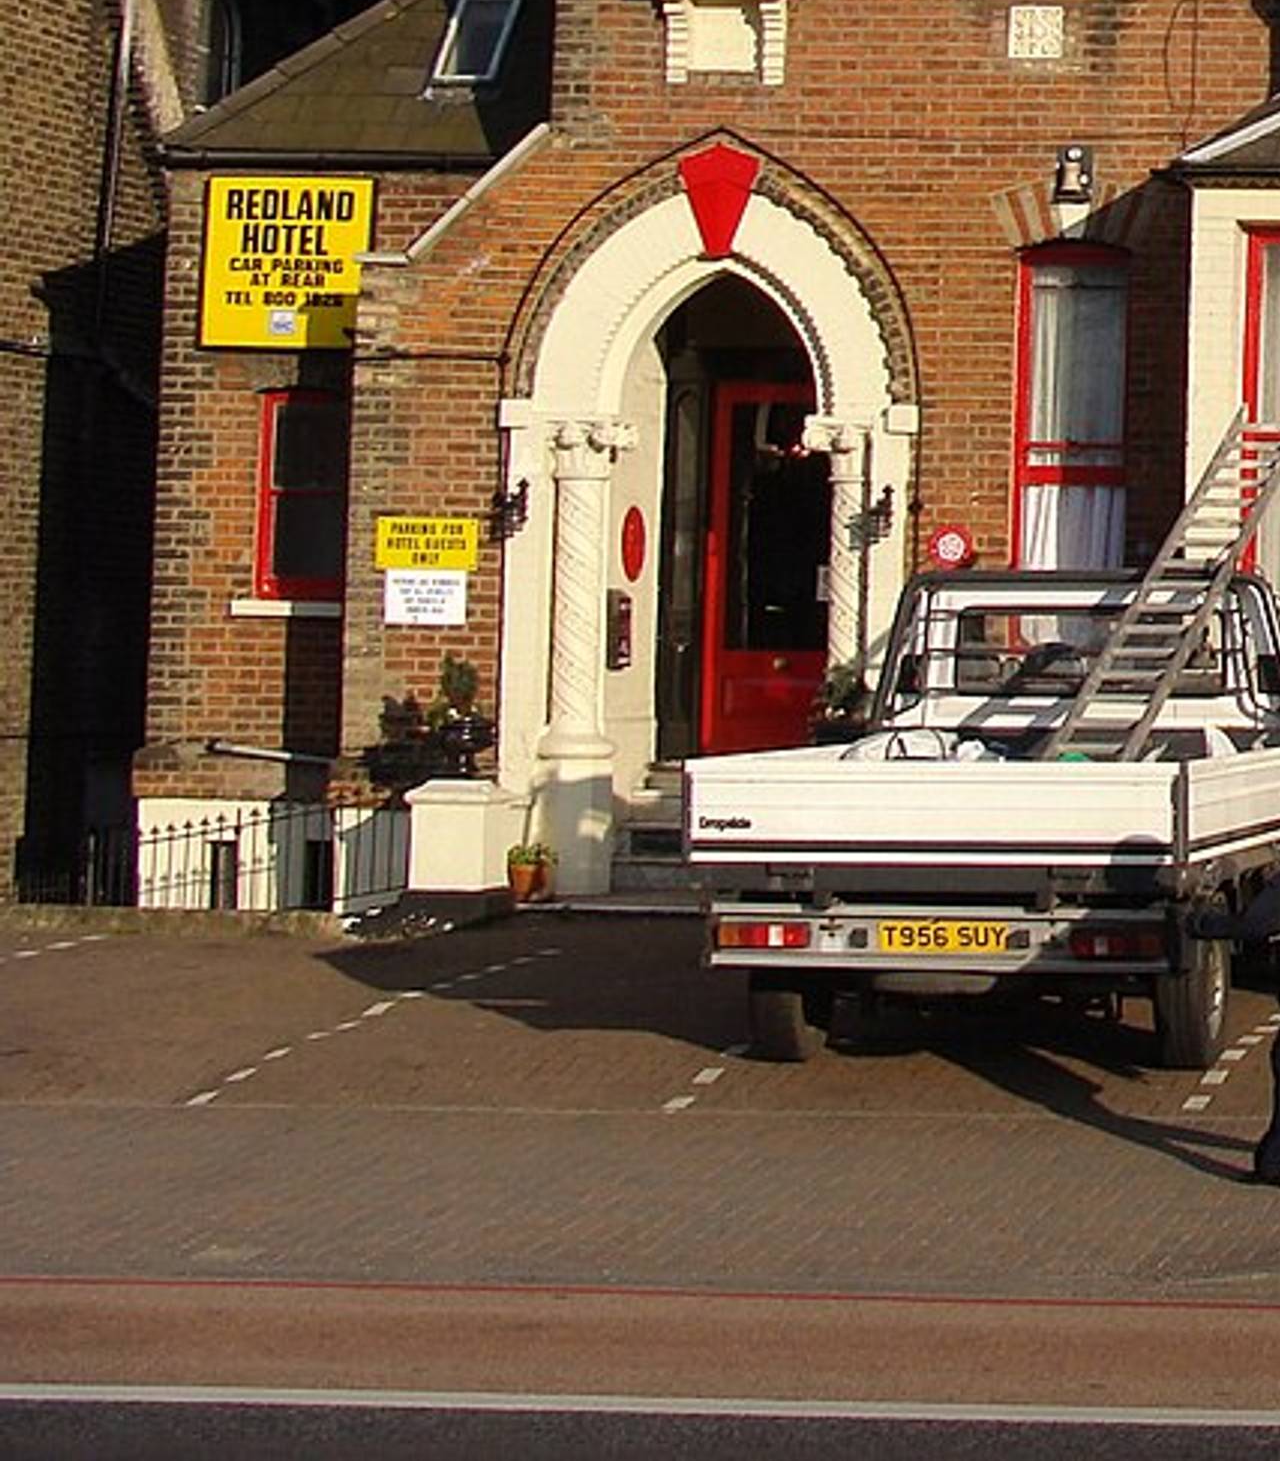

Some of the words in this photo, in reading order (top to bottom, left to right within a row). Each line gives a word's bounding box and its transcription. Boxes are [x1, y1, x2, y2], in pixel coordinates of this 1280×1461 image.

[226, 189, 355, 221] REDLAND
[241, 223, 328, 256] HOTEL
[229, 257, 263, 271] CAR
[271, 258, 344, 274] PARKING
[249, 273, 271, 286] AT
[280, 273, 326, 288] REAR
[225, 291, 253, 306] TEL
[882, 926, 950, 948] T956
[956, 926, 1007, 948] SUY
